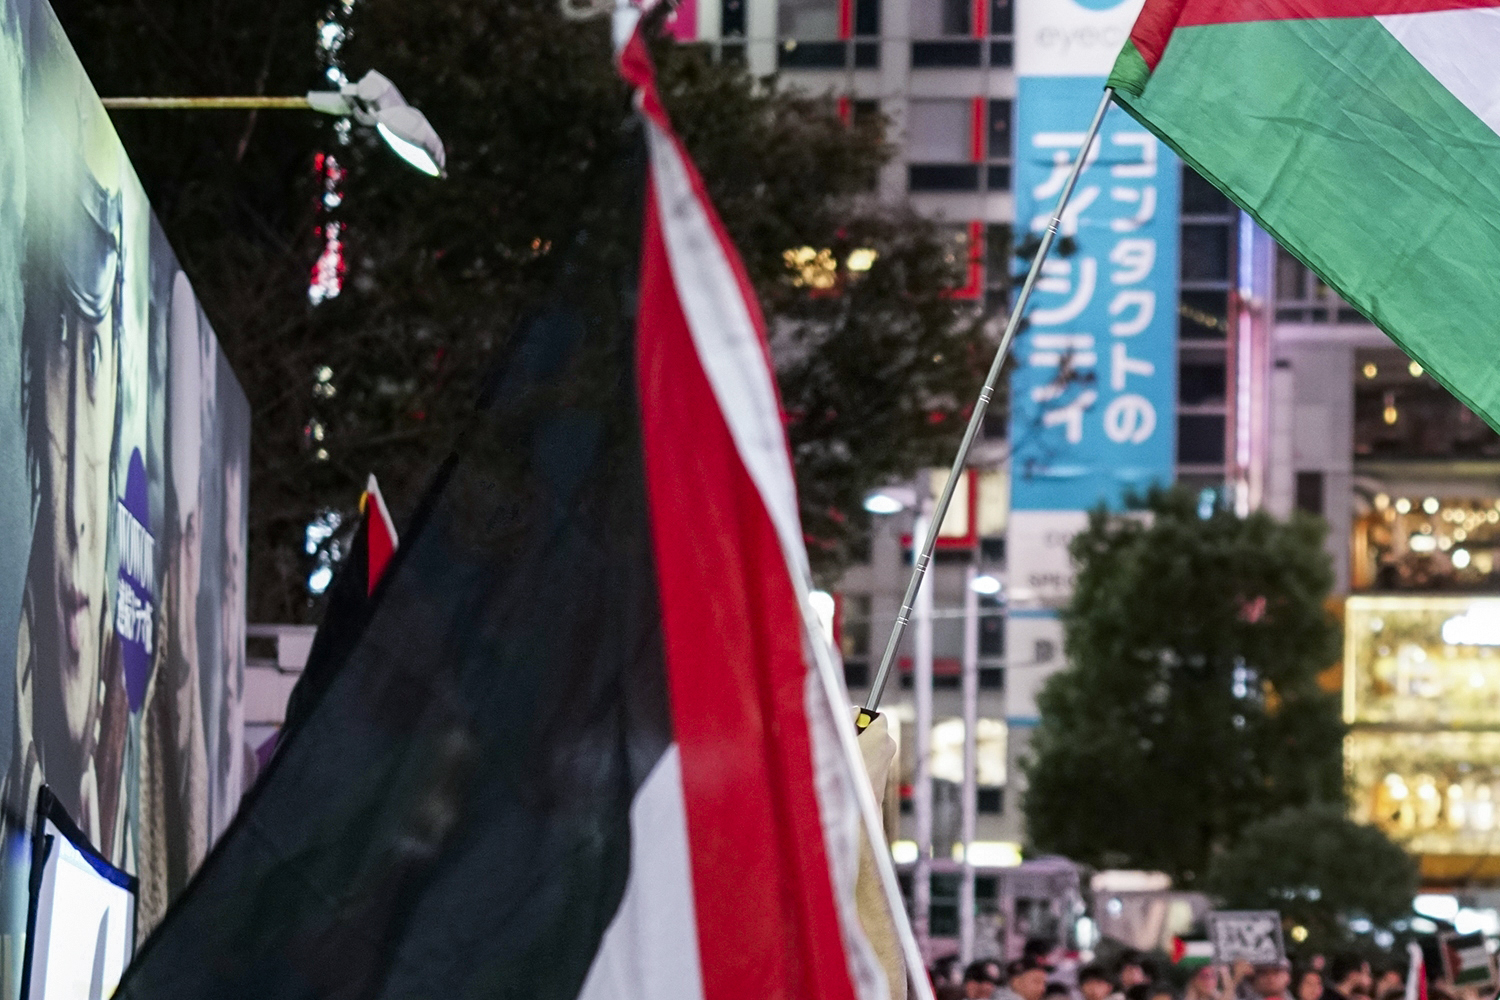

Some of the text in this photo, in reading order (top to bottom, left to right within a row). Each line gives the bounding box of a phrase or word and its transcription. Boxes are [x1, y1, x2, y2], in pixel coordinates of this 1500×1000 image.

[1031, 132, 1101, 444] アイシティ
[1104, 133, 1157, 444] コンタクトの
[118, 500, 155, 595] WOWOW
